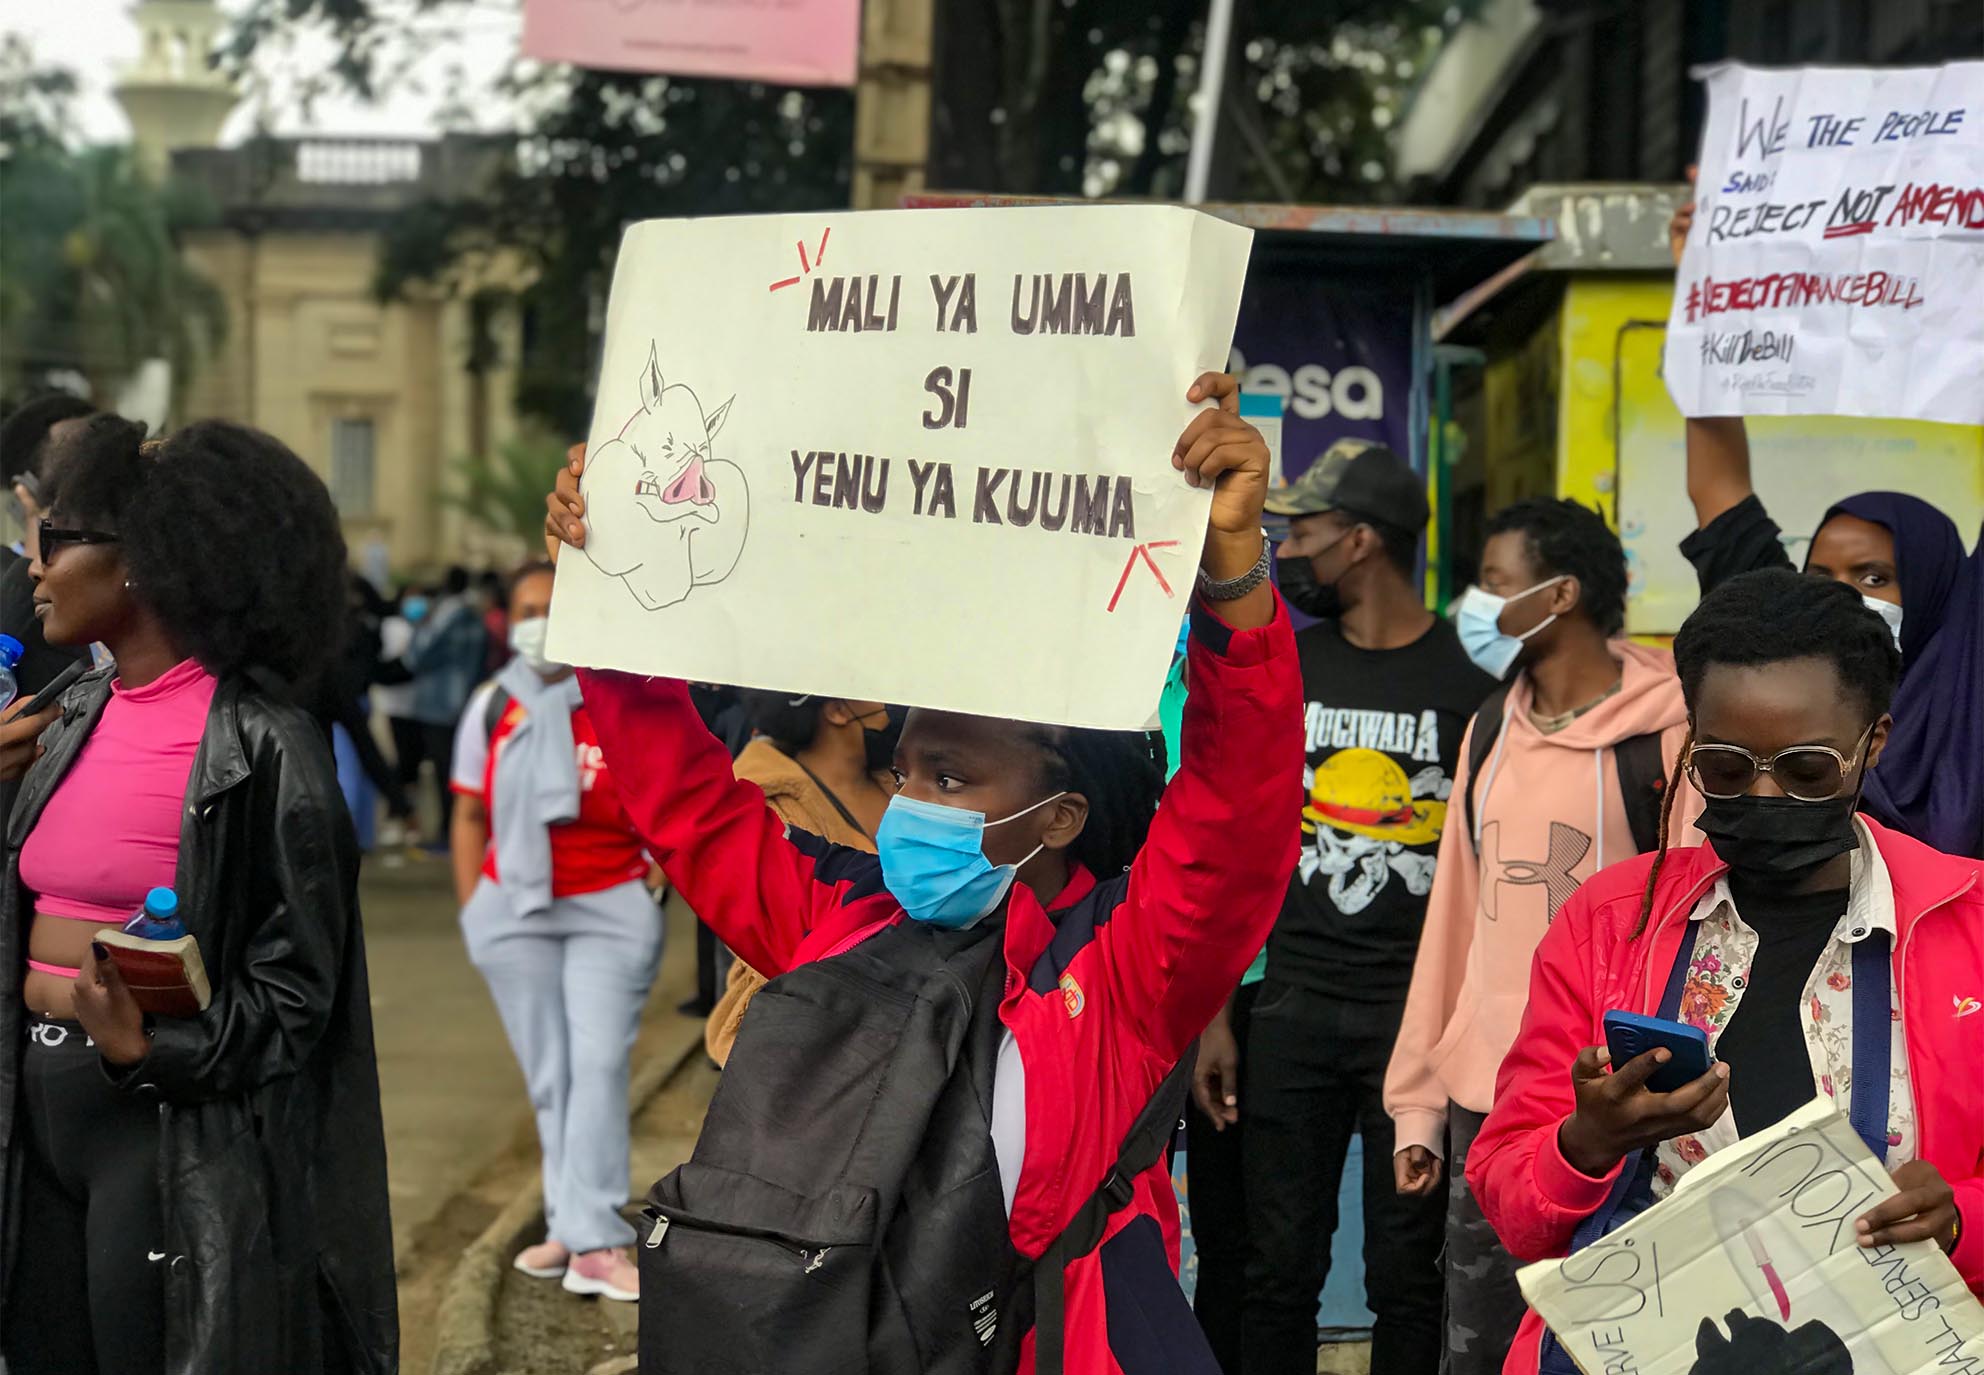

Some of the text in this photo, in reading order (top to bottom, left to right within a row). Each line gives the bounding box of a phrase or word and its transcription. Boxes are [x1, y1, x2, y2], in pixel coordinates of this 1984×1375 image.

[1736, 96, 1966, 160] WE THE PEOPLE
[1826, 184, 1896, 228] NOT
[805, 272, 1136, 337] MALI YA UMMA
[922, 366, 972, 429] SI
[1229, 346, 1384, 421] esa
[790, 450, 1136, 539] YENU YA KUUMA
[1857, 1244, 1940, 1321] SERVE
[1592, 1326, 1638, 1375] RVE
[1926, 1315, 1984, 1375] HALL
